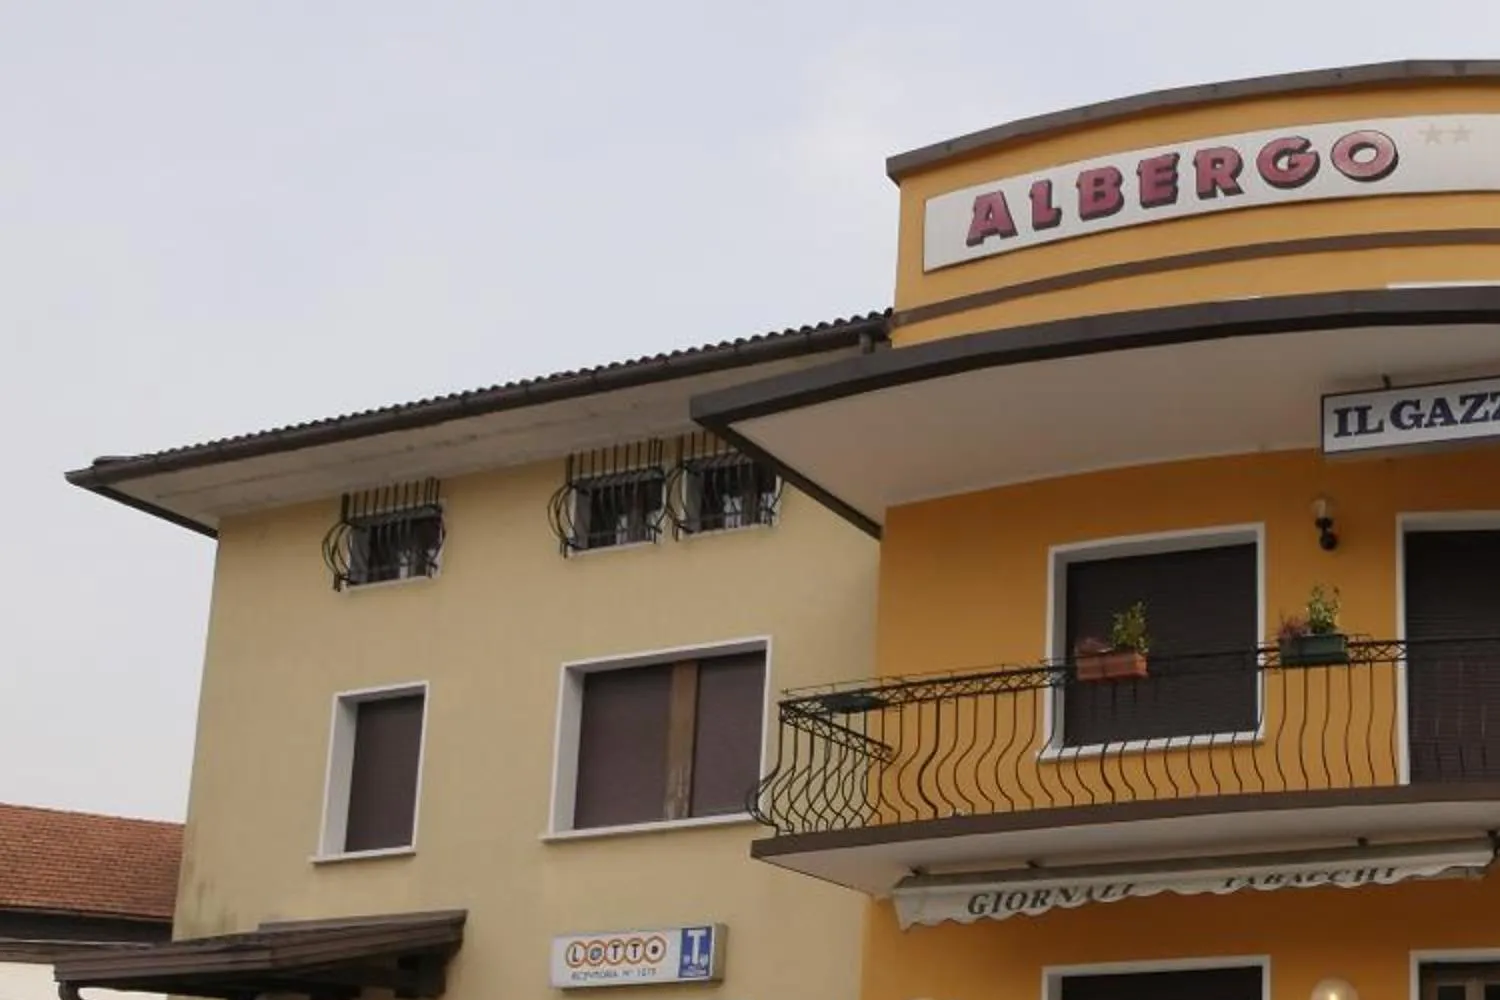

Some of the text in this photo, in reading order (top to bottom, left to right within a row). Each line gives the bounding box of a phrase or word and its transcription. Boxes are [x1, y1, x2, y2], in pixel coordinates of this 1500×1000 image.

[965, 129, 1399, 246] ALBERGO
[1333, 404, 1385, 438] IL
[567, 937, 666, 966] LOTTO
